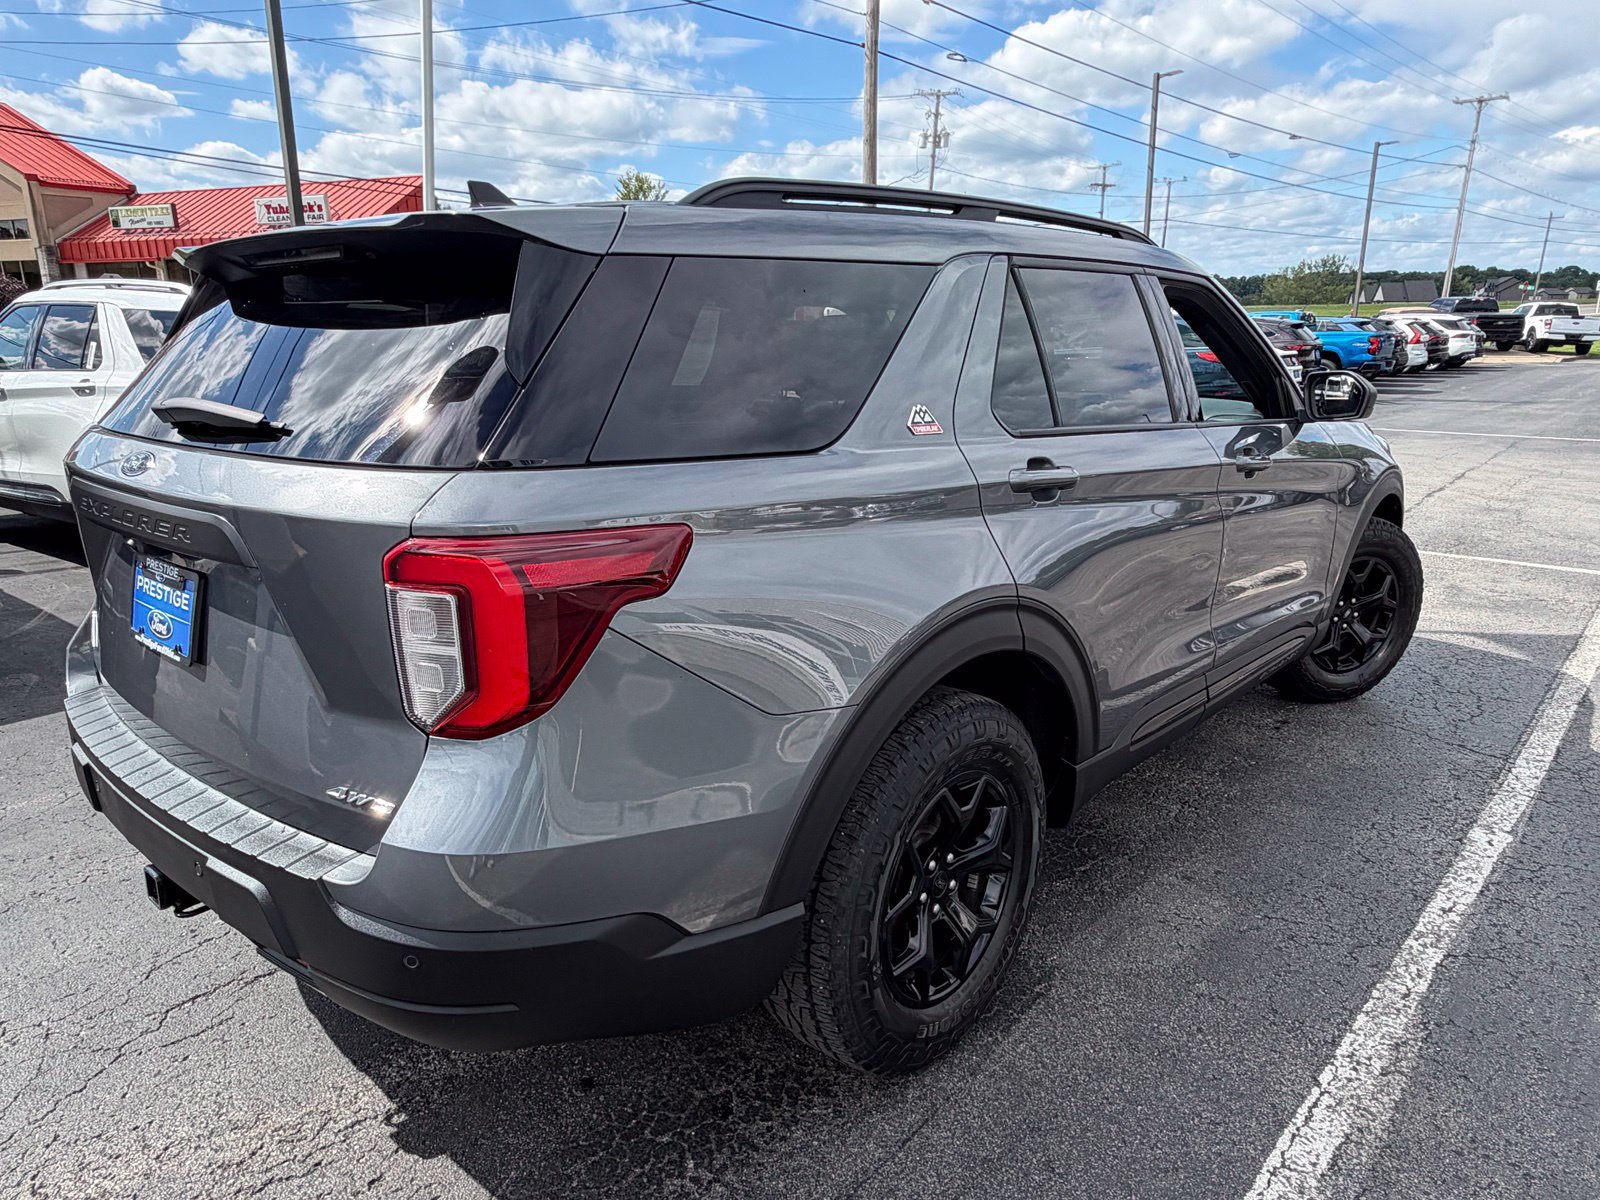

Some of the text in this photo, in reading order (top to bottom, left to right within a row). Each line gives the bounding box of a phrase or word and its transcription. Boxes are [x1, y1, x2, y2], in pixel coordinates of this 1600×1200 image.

[80, 497, 191, 543] EXPLORER
[146, 557, 179, 577] PRESTIGE
[137, 575, 190, 611] PRESTIGE
[151, 612, 168, 635] Ford
